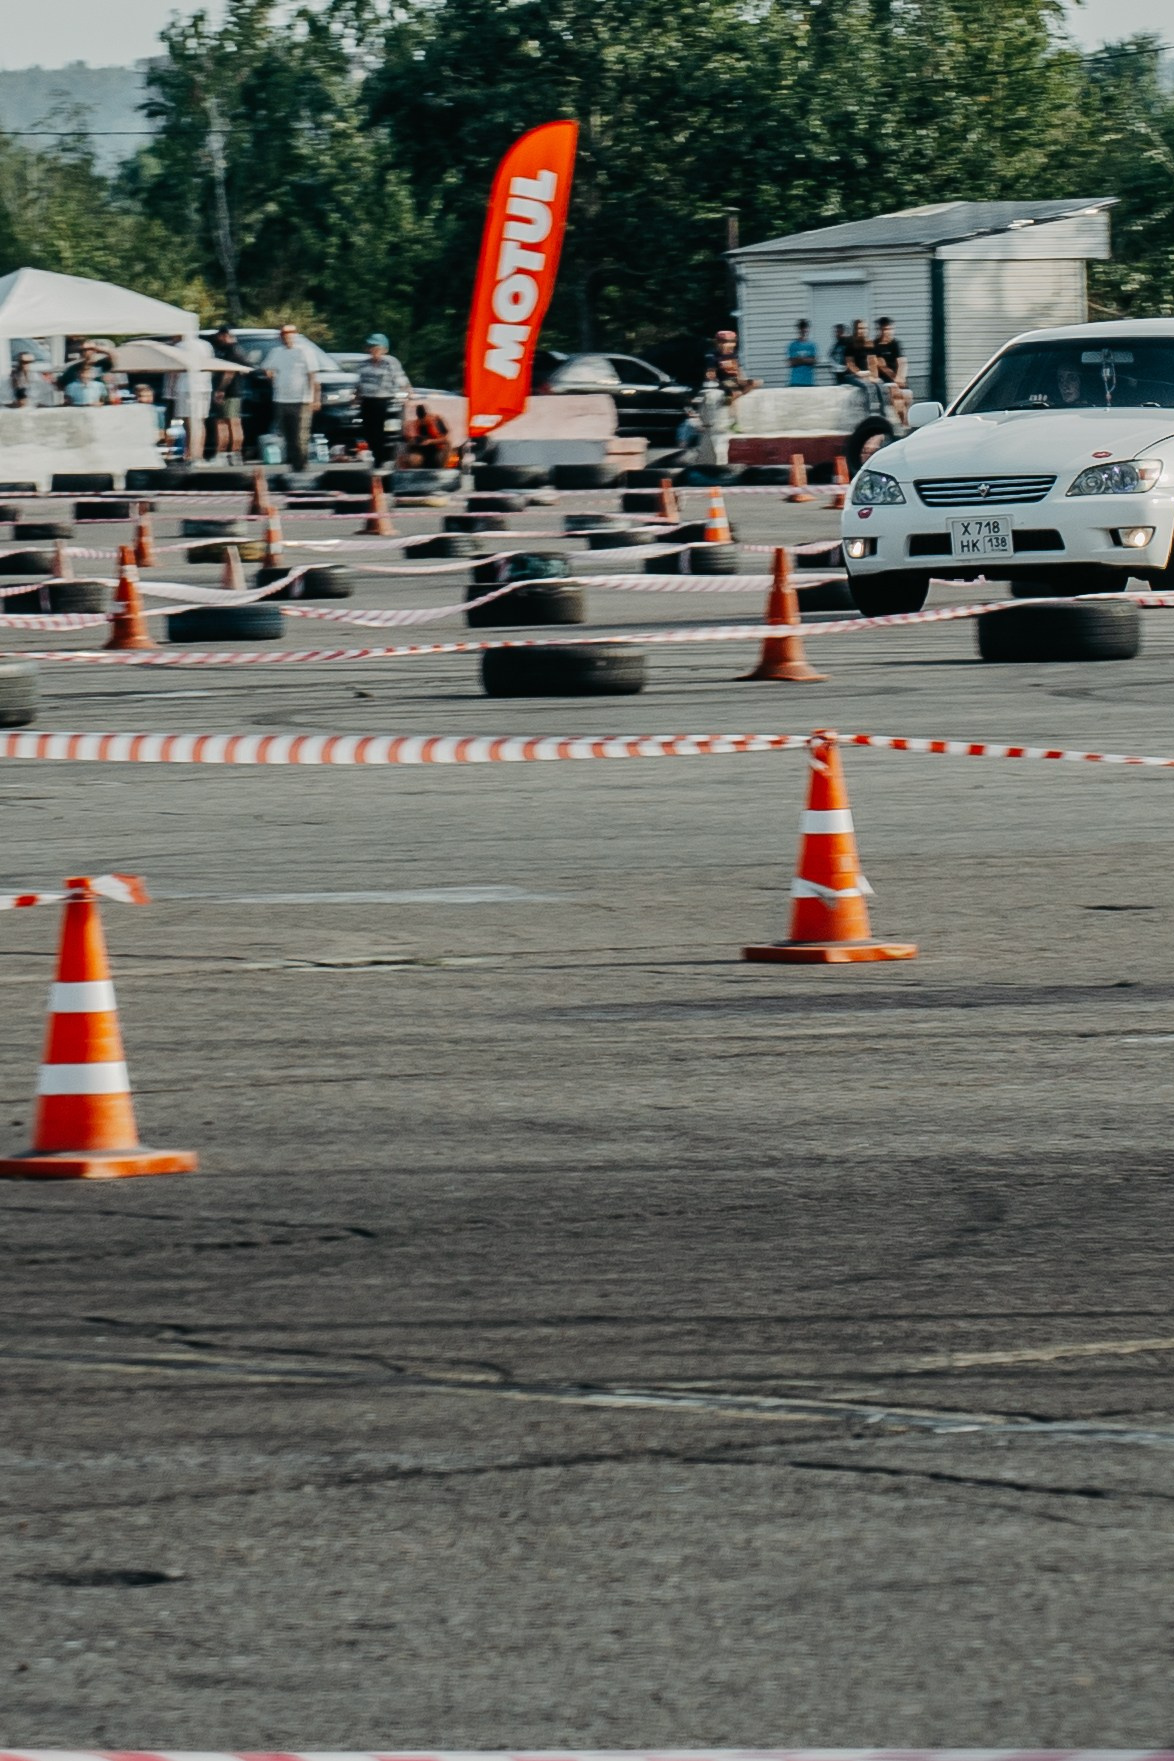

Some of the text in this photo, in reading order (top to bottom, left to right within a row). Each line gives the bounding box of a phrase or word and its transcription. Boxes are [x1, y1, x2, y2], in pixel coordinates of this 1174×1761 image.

[483, 169, 558, 380] MOTUL
[975, 520, 1001, 535] 718
[987, 536, 1008, 548] 138
